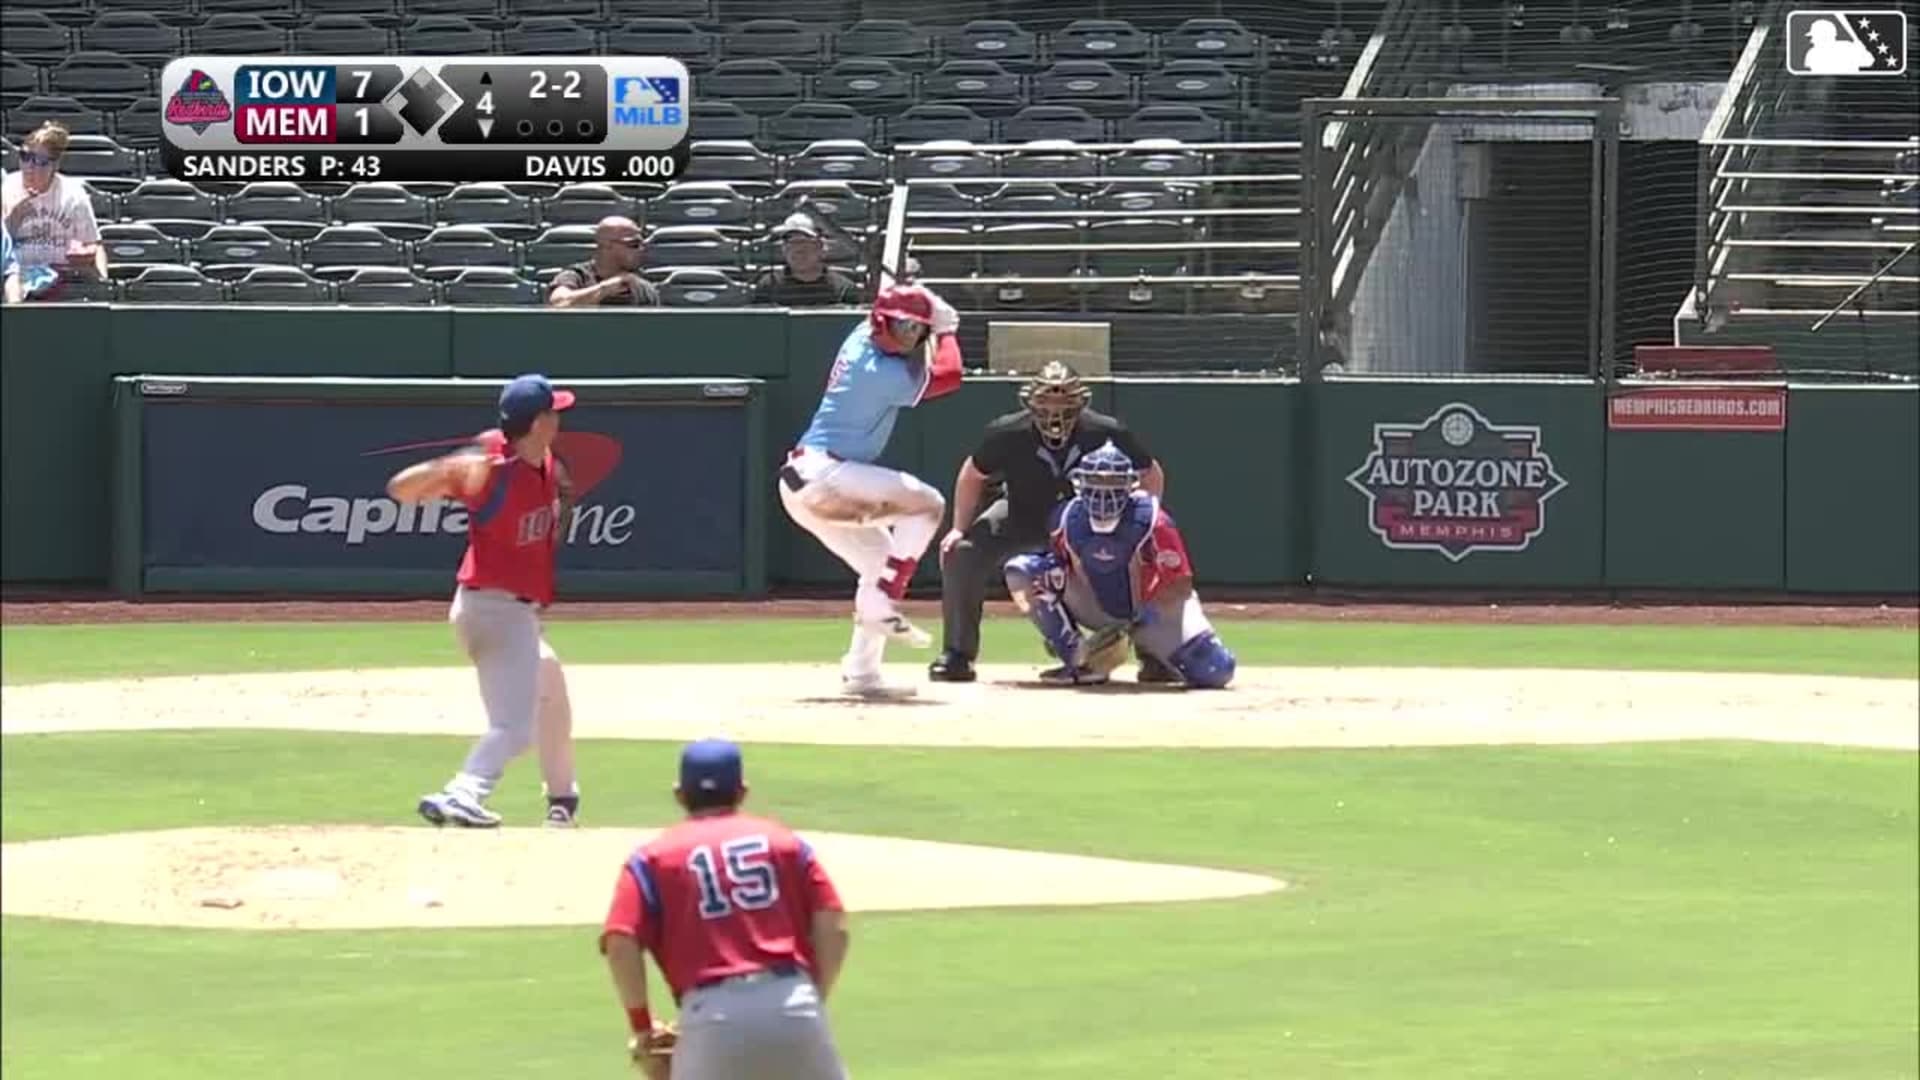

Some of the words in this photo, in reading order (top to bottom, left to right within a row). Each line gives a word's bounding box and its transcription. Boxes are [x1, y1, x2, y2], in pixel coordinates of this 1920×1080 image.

[1367, 458, 1547, 488] AUTOZONE
[1412, 489, 1502, 519] PARK
[1400, 524, 1513, 539] MEMPHIS
[688, 834, 779, 919] 15
